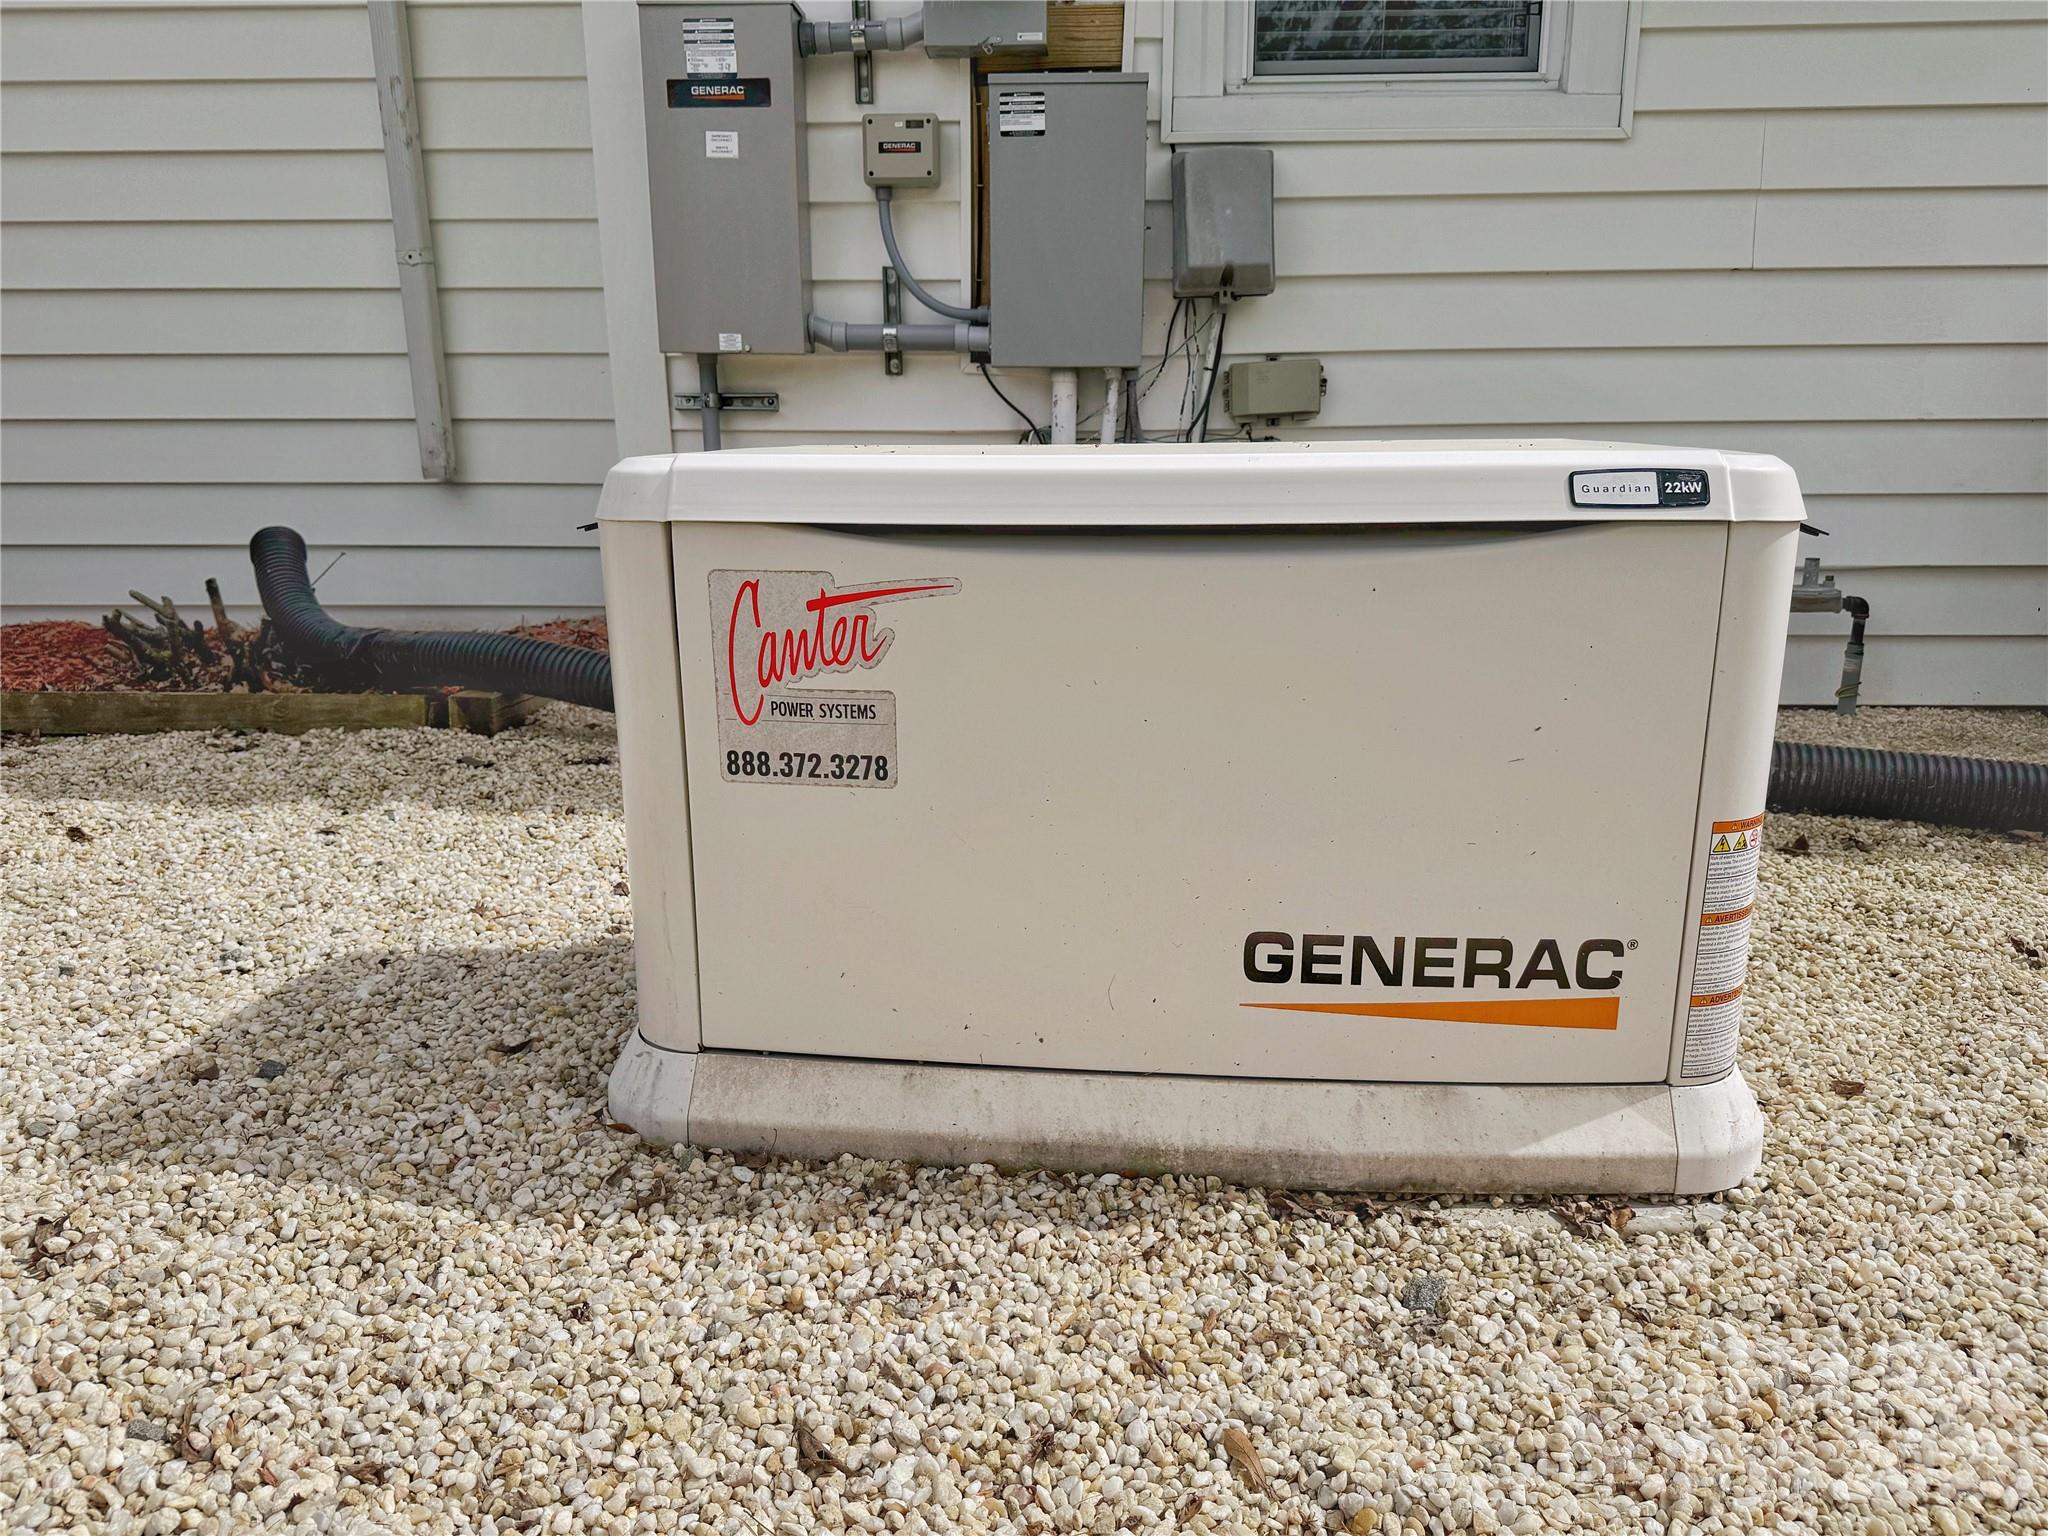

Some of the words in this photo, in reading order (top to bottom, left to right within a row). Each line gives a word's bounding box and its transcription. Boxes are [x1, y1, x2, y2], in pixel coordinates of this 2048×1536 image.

[691, 86, 745, 95] GENERAC
[1581, 484, 1651, 494] Guardian
[1664, 482, 1702, 493] 22kW
[729, 579, 954, 726] Canter
[770, 701, 814, 718] POWER
[819, 703, 877, 720] SYSTEMS
[726, 750, 889, 781] 888.372.3278
